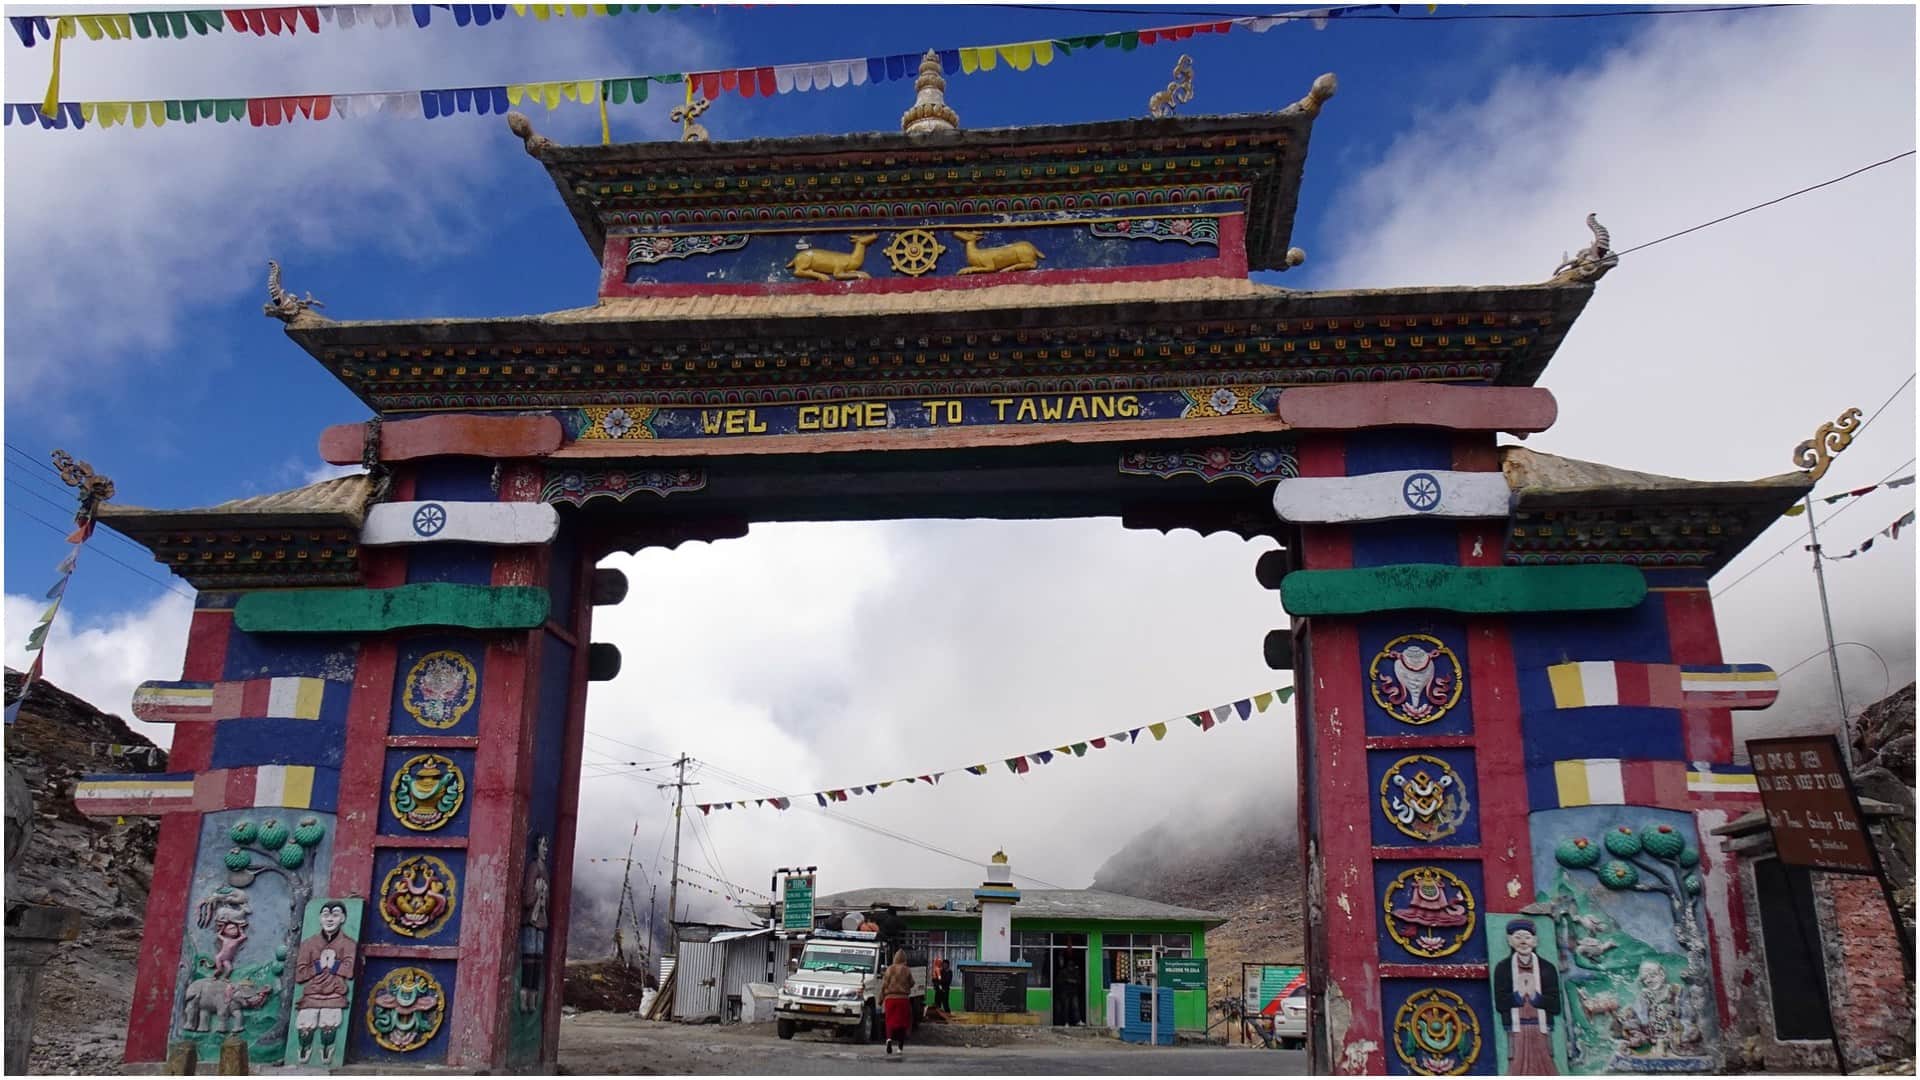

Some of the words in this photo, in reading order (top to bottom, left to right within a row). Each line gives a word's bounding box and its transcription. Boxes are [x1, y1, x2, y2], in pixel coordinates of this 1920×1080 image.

[702, 409, 767, 435] WEL
[799, 402, 888, 430] COME
[922, 400, 962, 425] TO
[990, 395, 1139, 421] TAWANG
